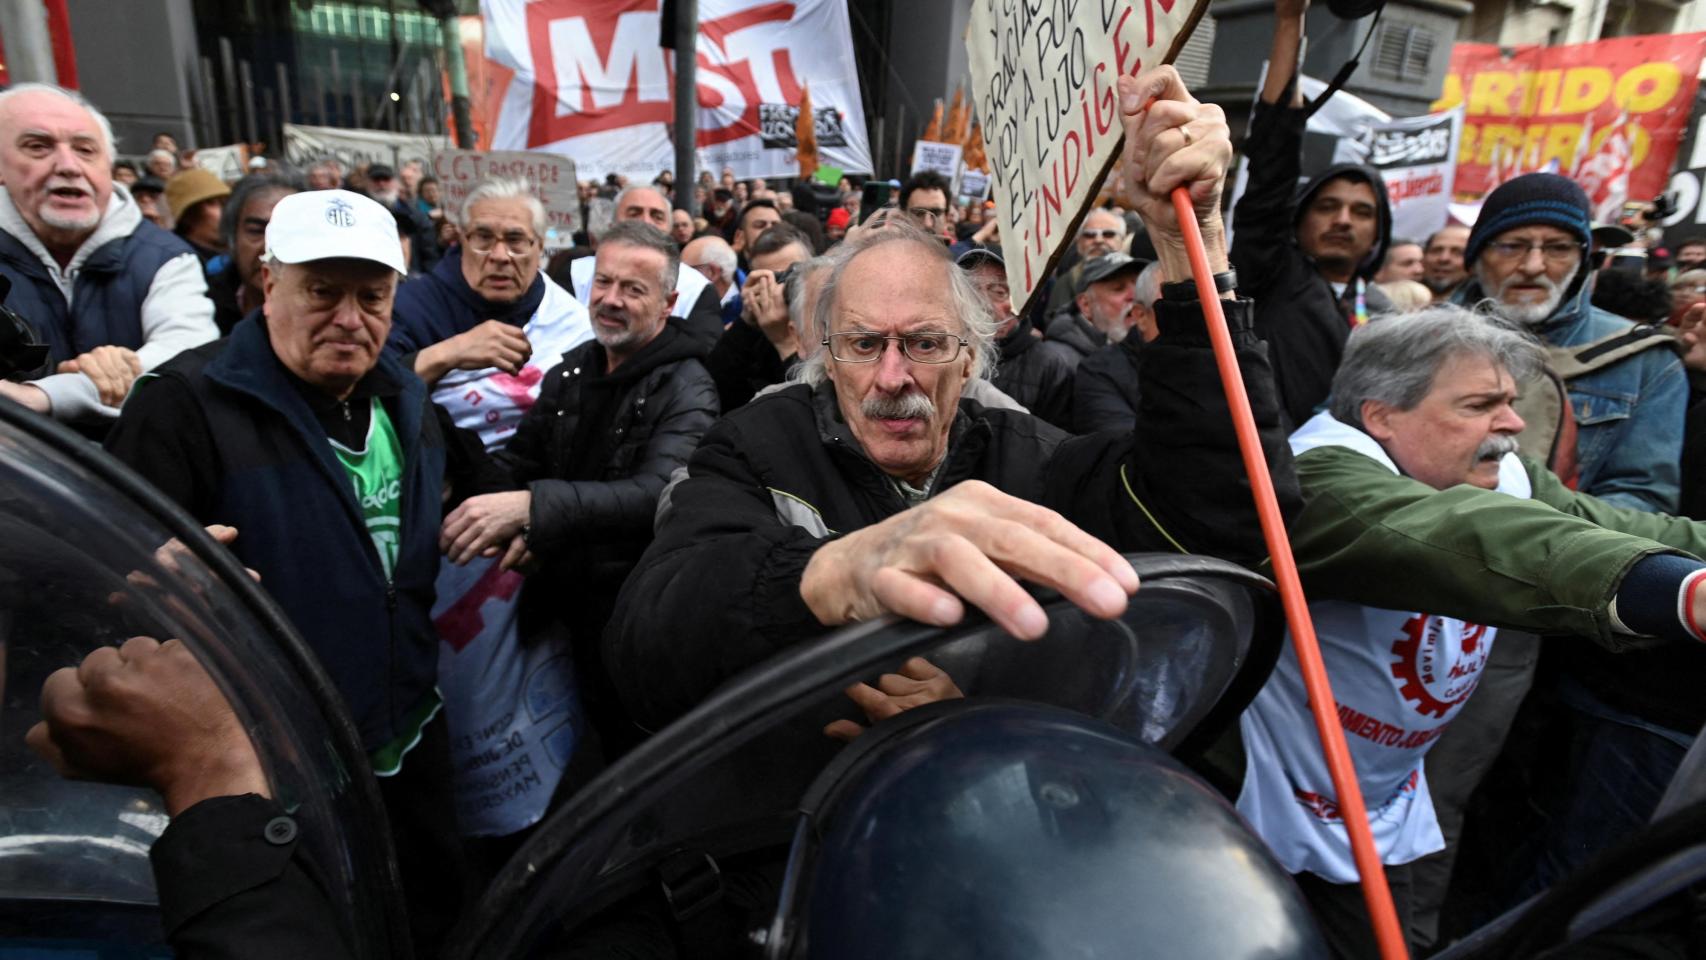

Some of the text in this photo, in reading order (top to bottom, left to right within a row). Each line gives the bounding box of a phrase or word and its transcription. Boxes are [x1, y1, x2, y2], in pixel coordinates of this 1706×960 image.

[992, 97, 1018, 188] VOY
[1022, 68, 1034, 121] A
[1009, 26, 1086, 229] EL LUJO
